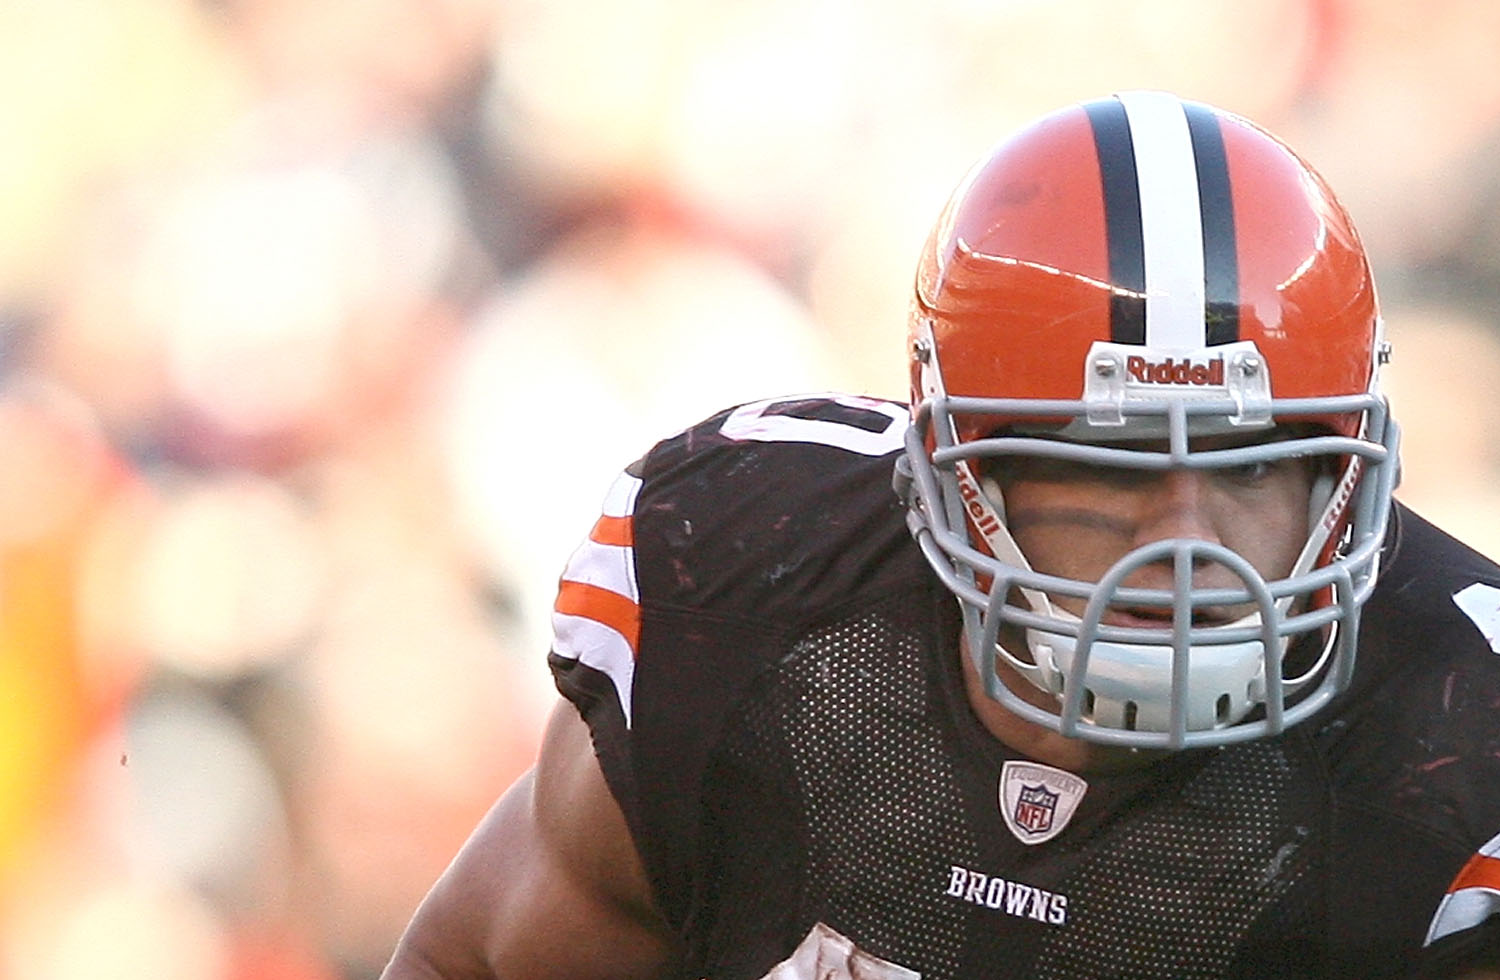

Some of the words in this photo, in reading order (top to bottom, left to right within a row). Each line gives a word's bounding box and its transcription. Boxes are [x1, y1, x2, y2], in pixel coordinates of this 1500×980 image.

[1127, 355, 1224, 386] Riddell
[1016, 802, 1051, 831] NFL
[947, 865, 1069, 925] BROWNS
